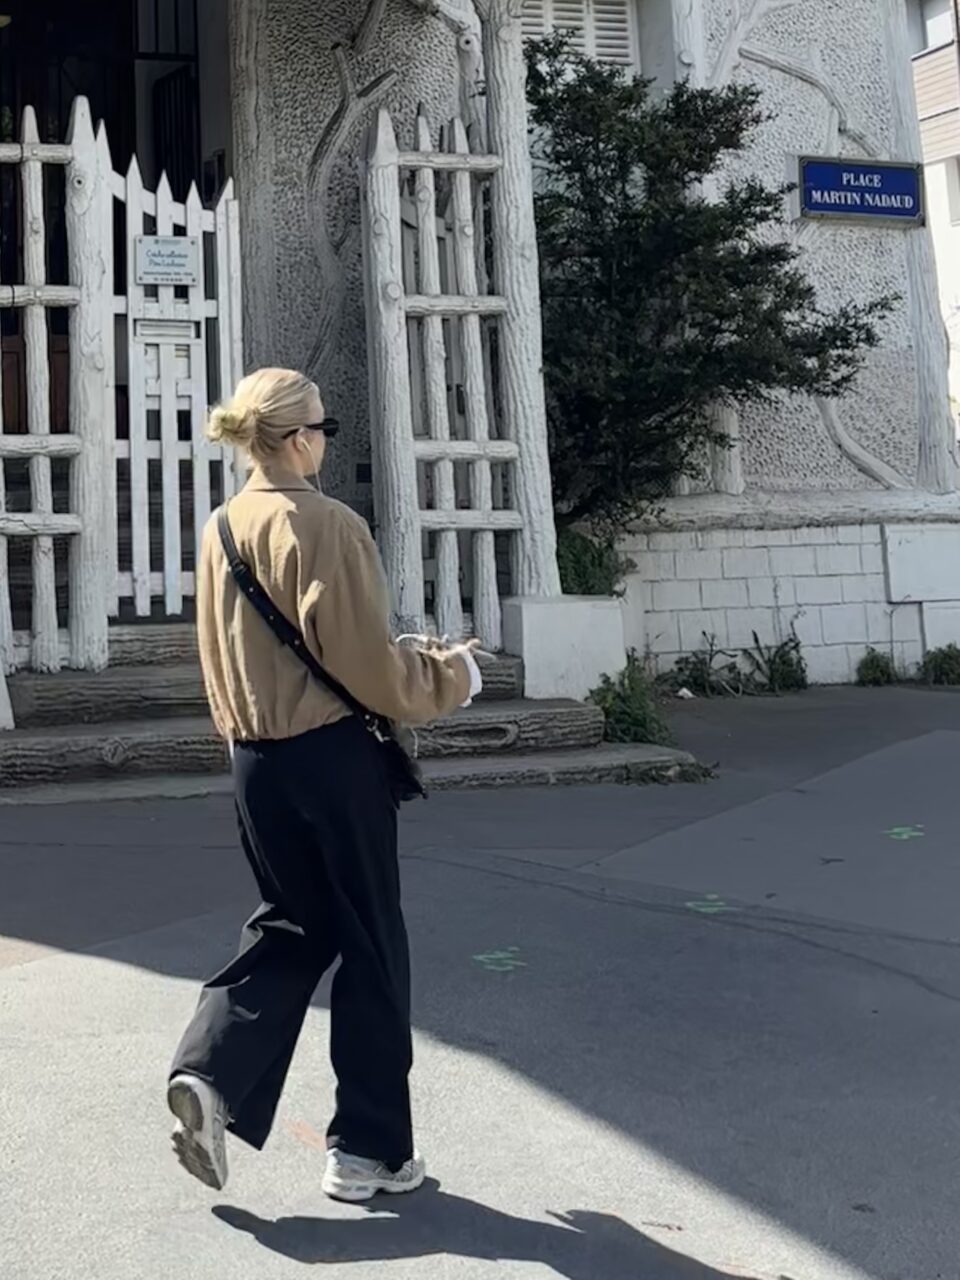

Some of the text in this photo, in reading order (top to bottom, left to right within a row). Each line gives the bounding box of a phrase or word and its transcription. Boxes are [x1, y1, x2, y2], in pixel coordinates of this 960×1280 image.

[842, 172, 882, 188] PLACE
[811, 190, 913, 209] MARTIN NADAUD
